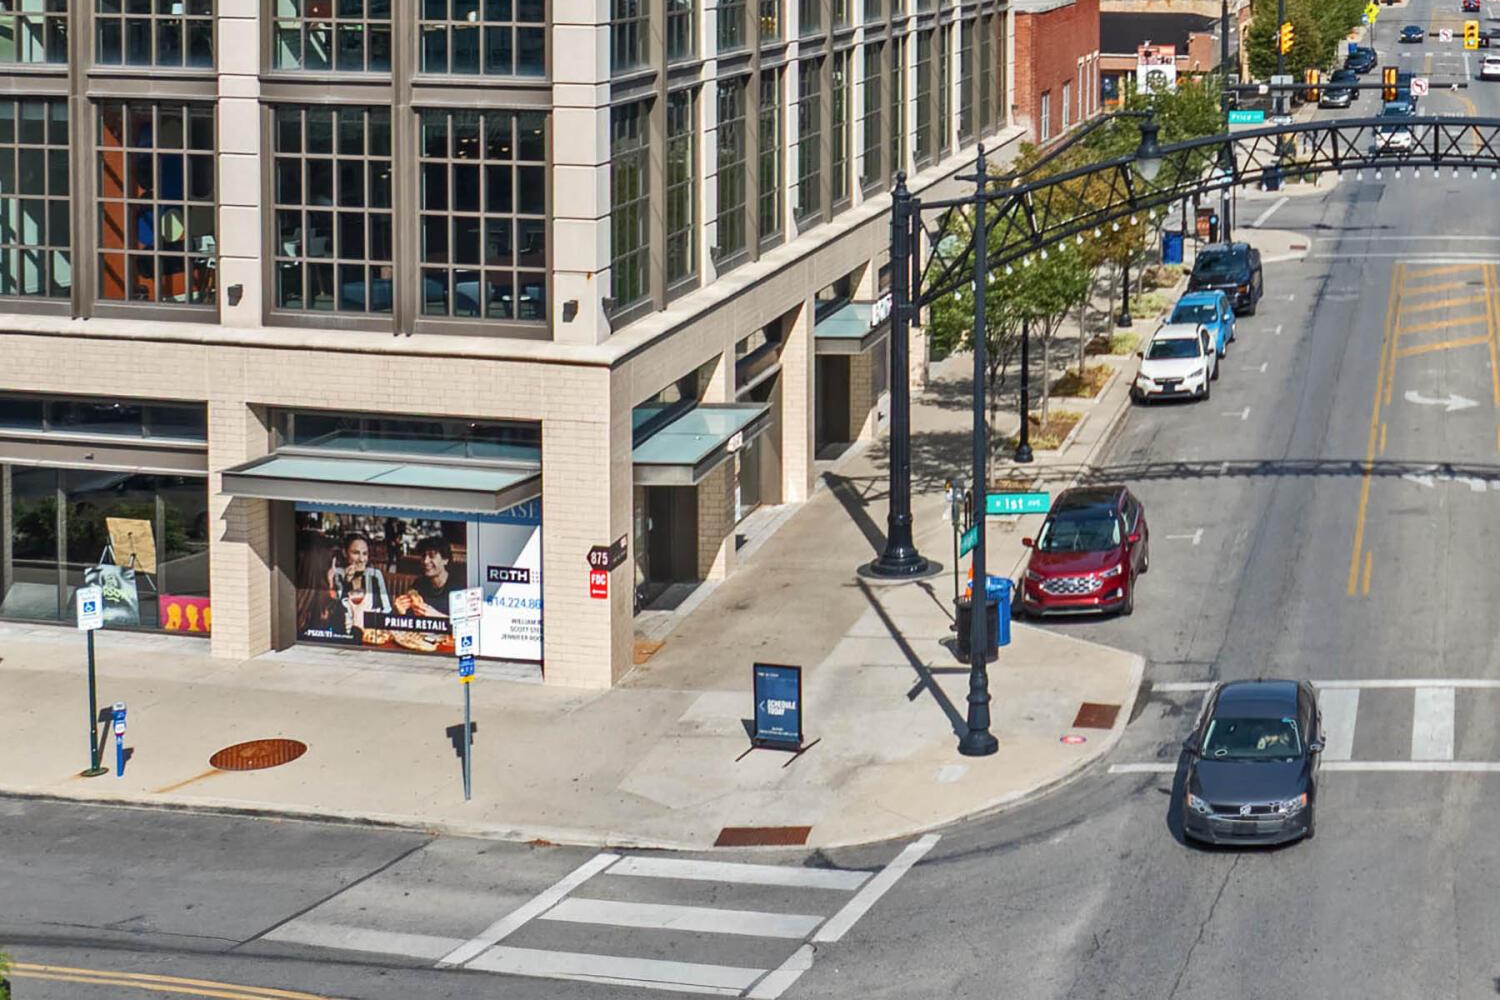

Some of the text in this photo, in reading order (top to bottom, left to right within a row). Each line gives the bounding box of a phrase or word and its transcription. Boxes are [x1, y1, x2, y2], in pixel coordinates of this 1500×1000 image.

[1005, 498, 1023, 509] 1st
[591, 552, 608, 565] 875
[490, 569, 528, 581] ROTH
[591, 574, 606, 585] FDC
[385, 617, 447, 630] PRIME RETAIL
